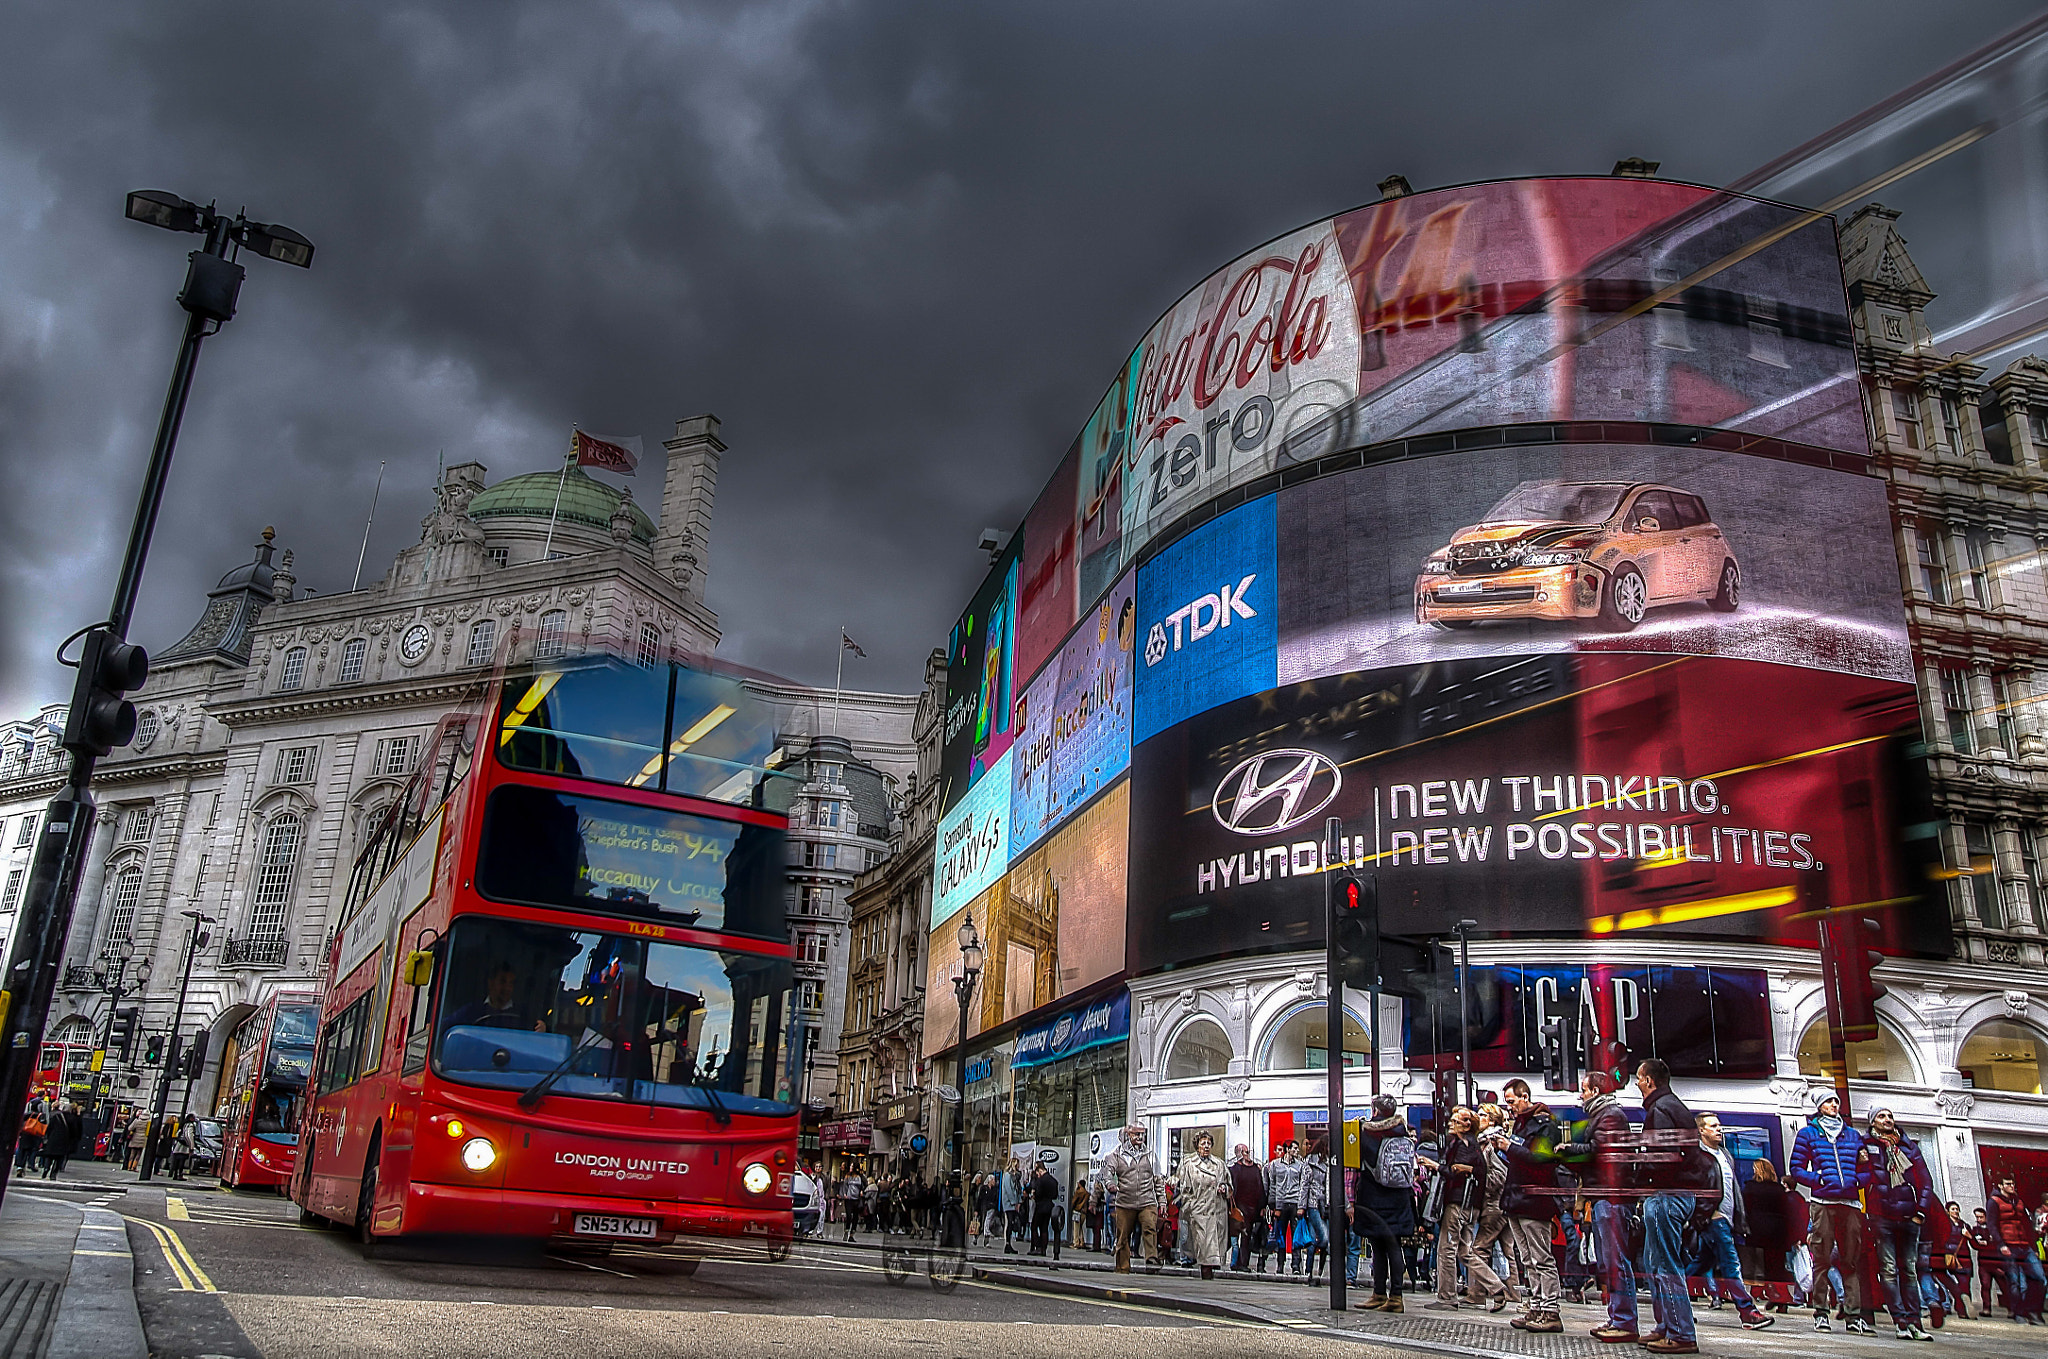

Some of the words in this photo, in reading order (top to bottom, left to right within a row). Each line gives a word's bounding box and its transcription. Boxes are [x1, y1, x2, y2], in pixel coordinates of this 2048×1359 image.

[1129, 242, 1331, 472] Coca-Cola
[1150, 395, 1275, 511] zero
[1165, 573, 1258, 652] TDK
[946, 702, 968, 746] GALAXY
[1022, 733, 1050, 780] Little
[1054, 667, 1117, 750] Piccdilly
[1389, 777, 1491, 819] NEW
[1501, 775, 1730, 815] THINKING.
[587, 831, 648, 850] Shepherd's
[651, 838, 679, 854] Bush
[943, 812, 973, 856] Samsung
[1391, 825, 1493, 867] NEW
[1506, 822, 1824, 871] POSSIBILITIES.
[940, 831, 982, 899] GALAXY
[628, 922, 650, 935] TLA
[1082, 1003, 1112, 1032] beauty
[1536, 976, 1639, 1056] GAP
[279, 1056, 309, 1069] Piccadilly
[555, 1152, 621, 1168] LONDON
[627, 1158, 690, 1175] UNITED
[626, 1172, 653, 1181] GROUP
[581, 1216, 620, 1233] SN53
[622, 1219, 652, 1236] KJJ
